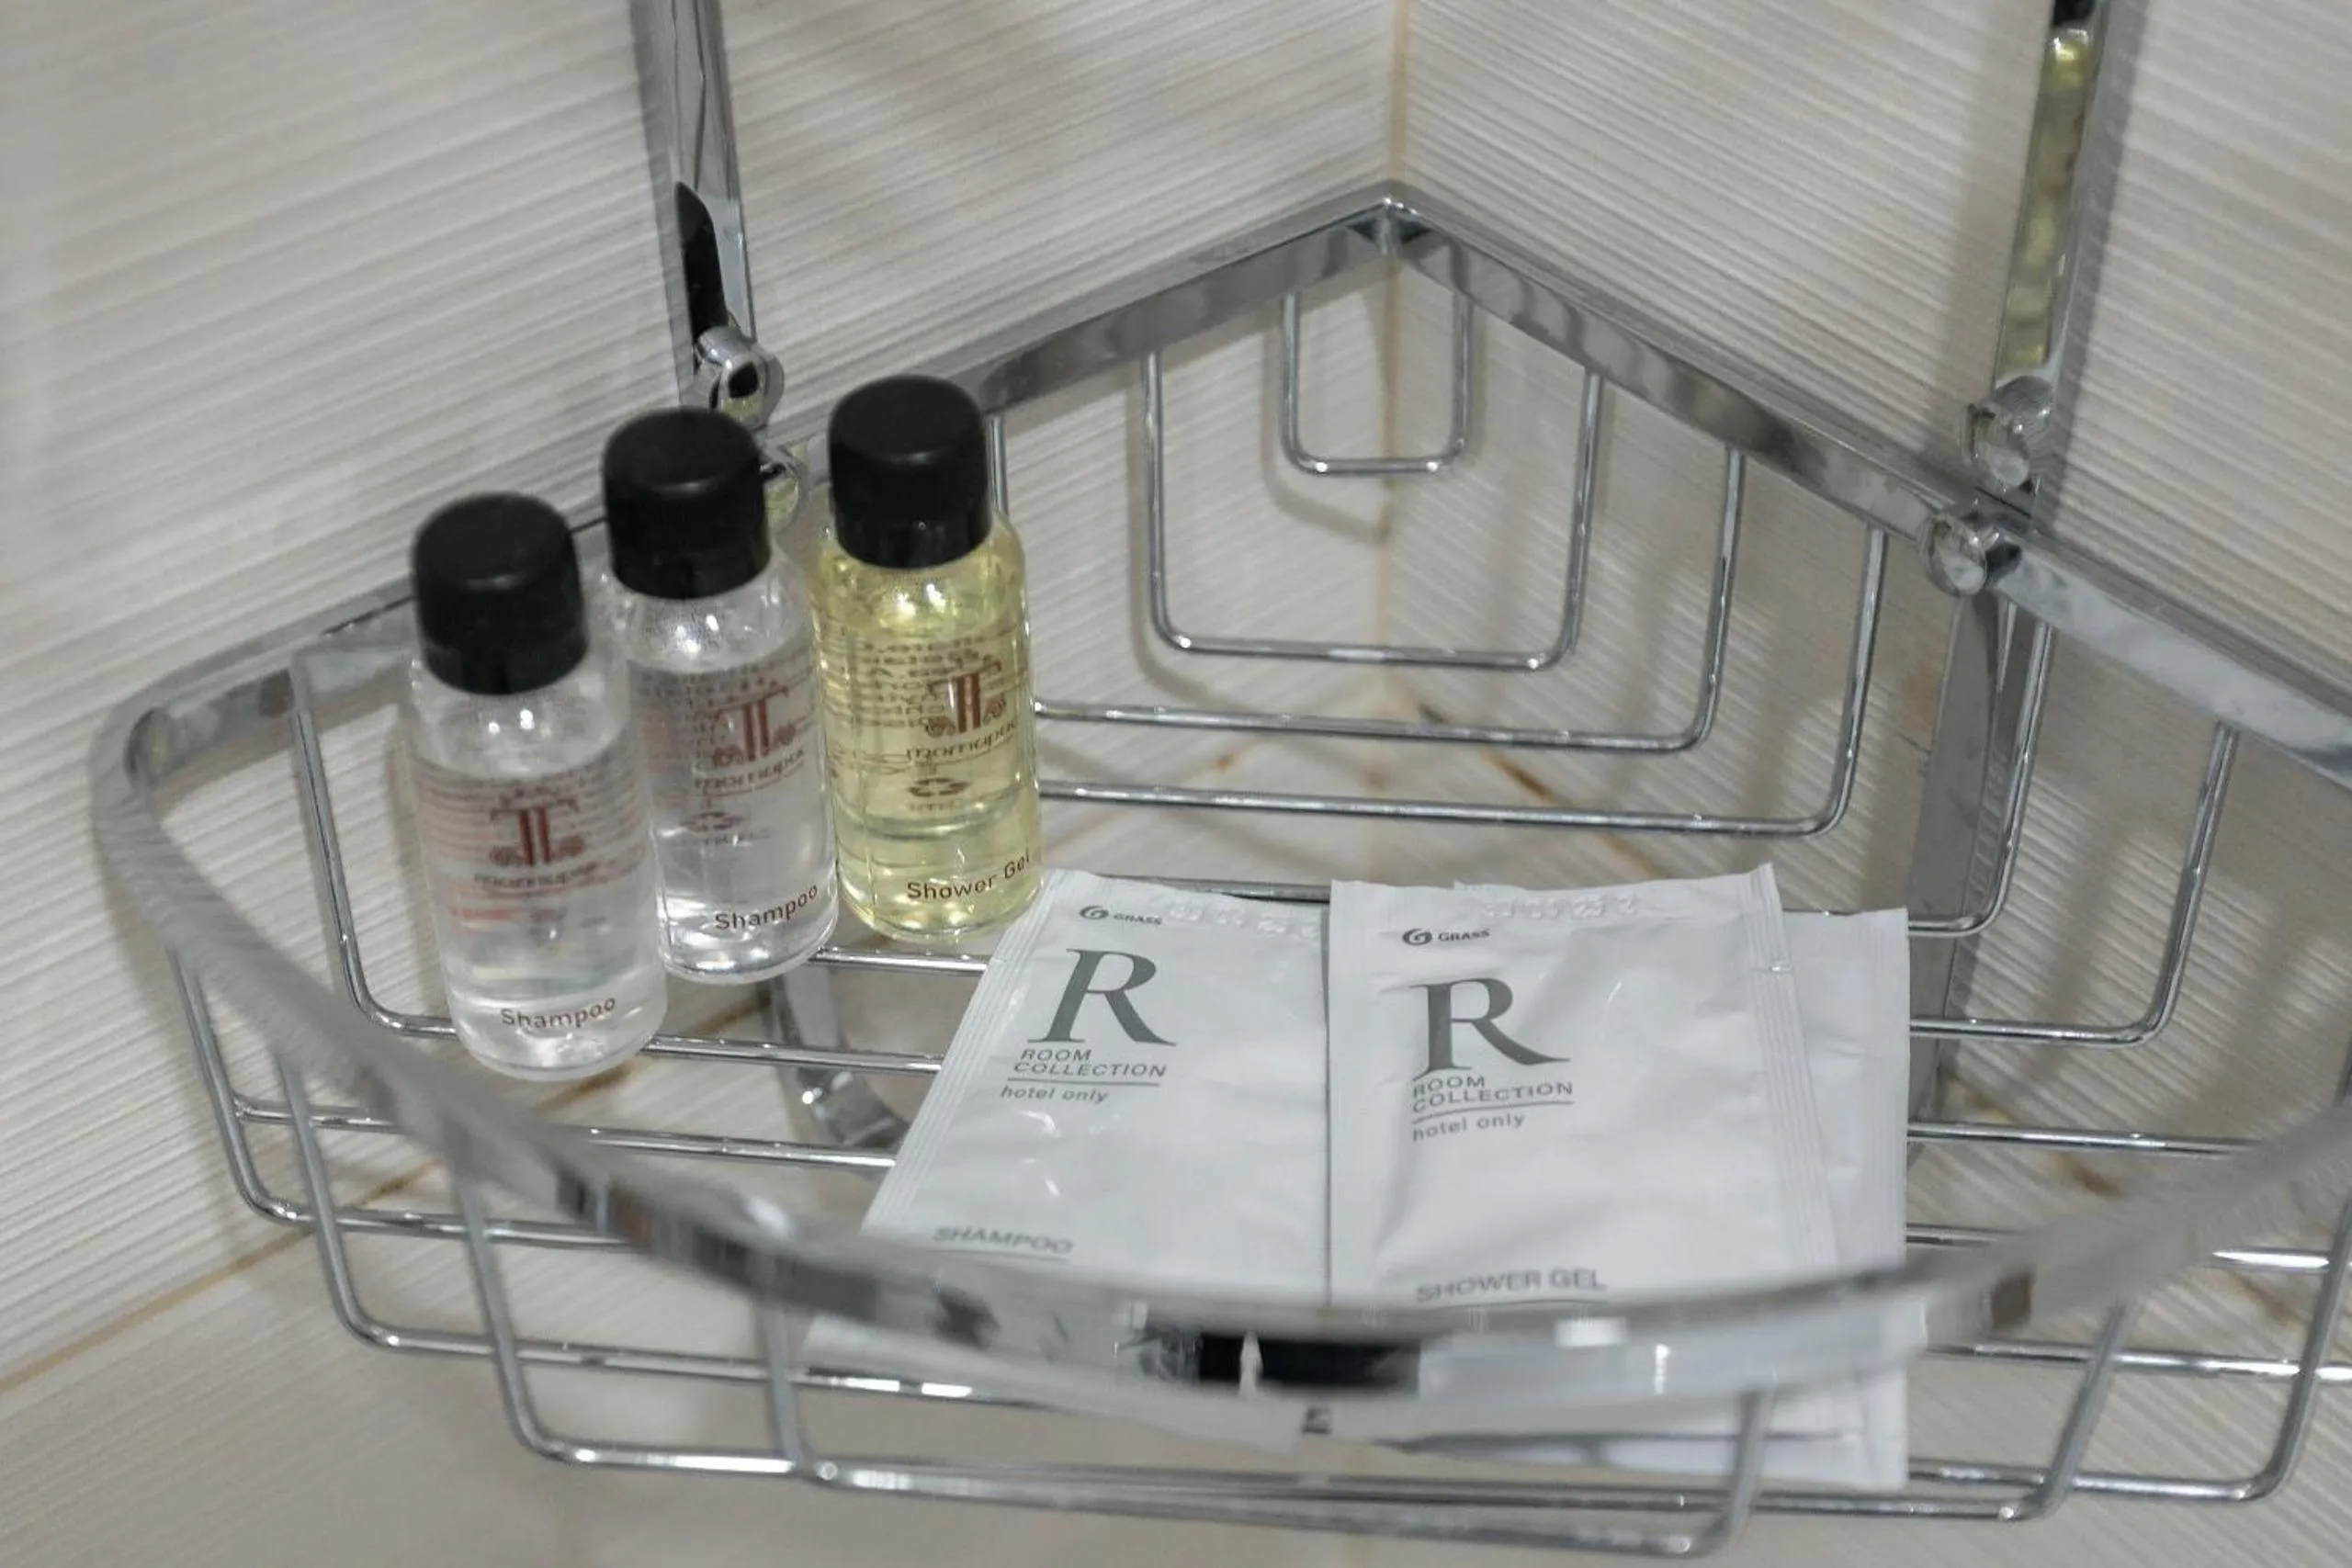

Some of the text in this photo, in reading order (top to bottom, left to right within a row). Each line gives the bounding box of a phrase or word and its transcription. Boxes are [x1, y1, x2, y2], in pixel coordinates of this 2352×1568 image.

[907, 846, 1031, 899] Shower Gel
[715, 884, 818, 931] Shampoo
[1438, 927, 1490, 942] GRASS
[500, 996, 616, 1029] Shampoo
[1026, 948, 1177, 1047] R
[1411, 977, 1571, 1082] R
[1012, 1061, 1167, 1078] COLLECTION
[1020, 1047, 1092, 1063] ROOM
[1001, 1085, 1110, 1104] hotel only
[1412, 1075, 1485, 1100] ROOM
[1412, 1080, 1574, 1114] COLLECTION
[1412, 1111, 1526, 1143] hotel only
[933, 1226, 1074, 1257] SHAMPOO
[1416, 1268, 1607, 1303] SHOWER GEL
